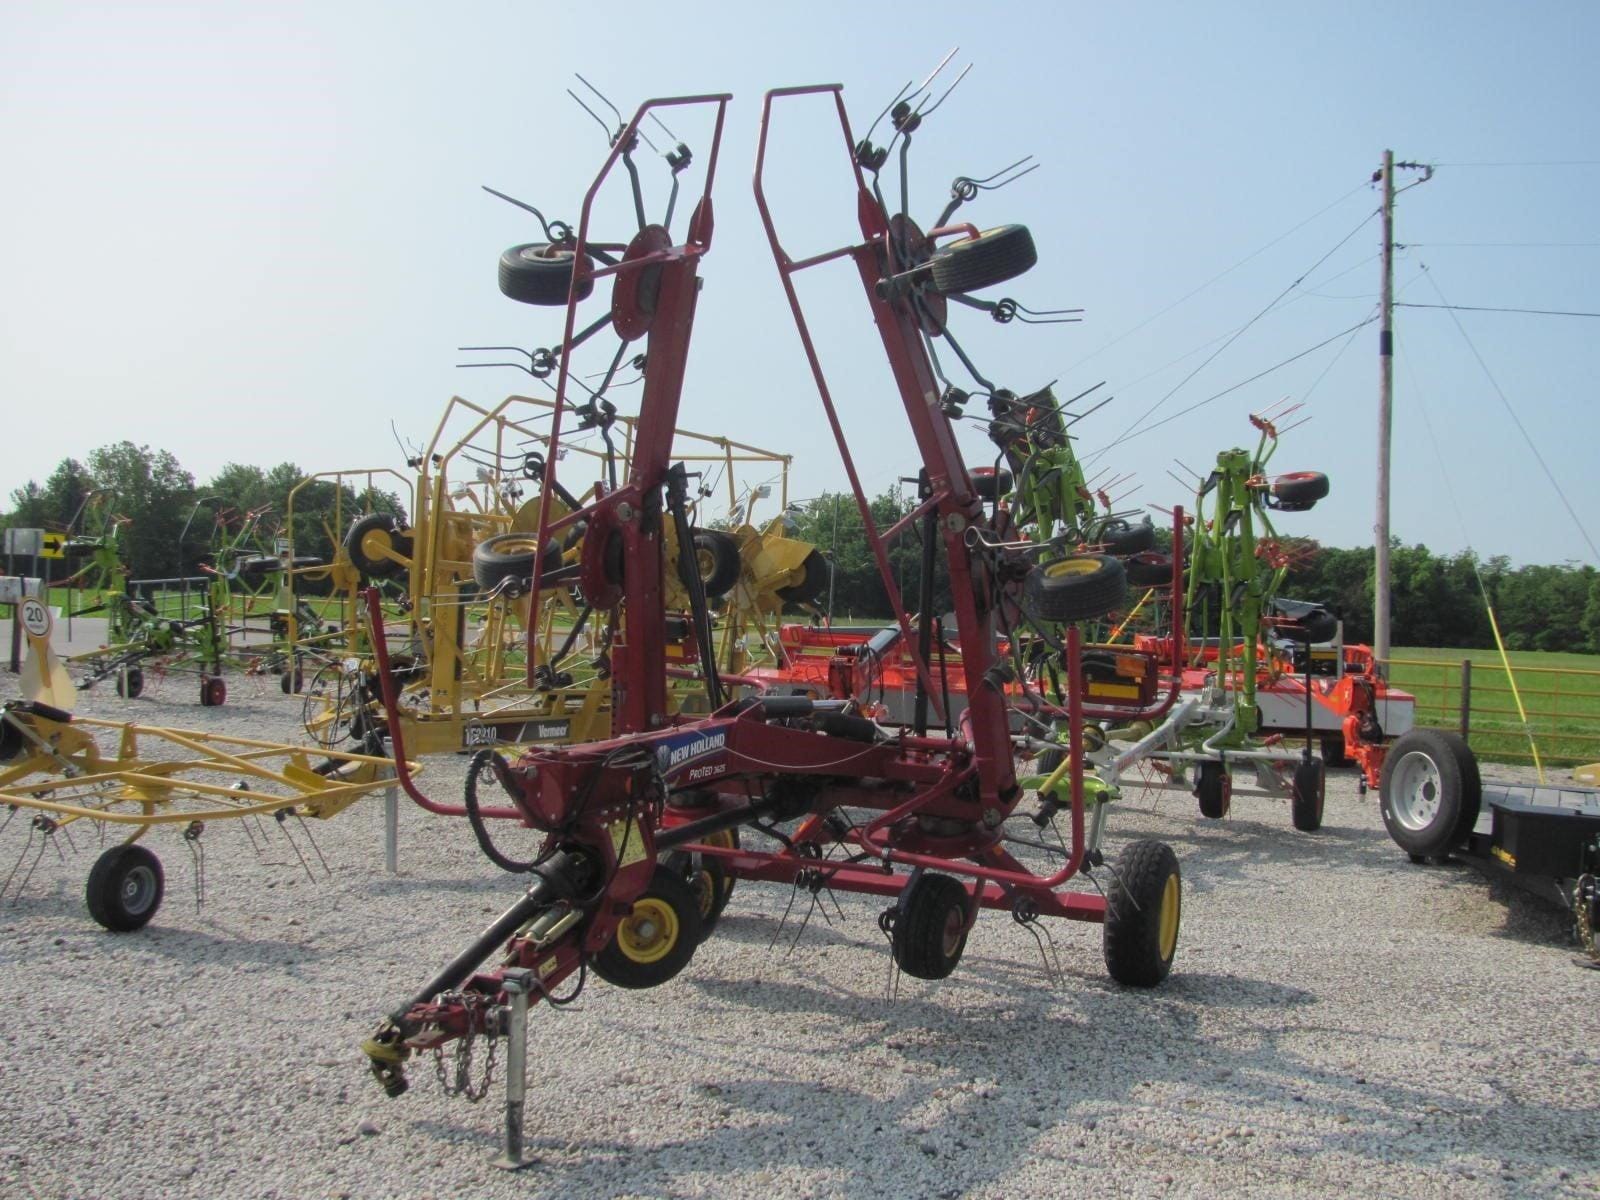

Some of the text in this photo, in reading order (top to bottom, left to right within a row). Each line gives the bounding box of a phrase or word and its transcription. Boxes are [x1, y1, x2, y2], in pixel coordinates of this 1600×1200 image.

[26, 606, 43, 622] 20
[538, 724, 568, 738] Vermeer
[670, 733, 725, 766] NEW HOLLAND
